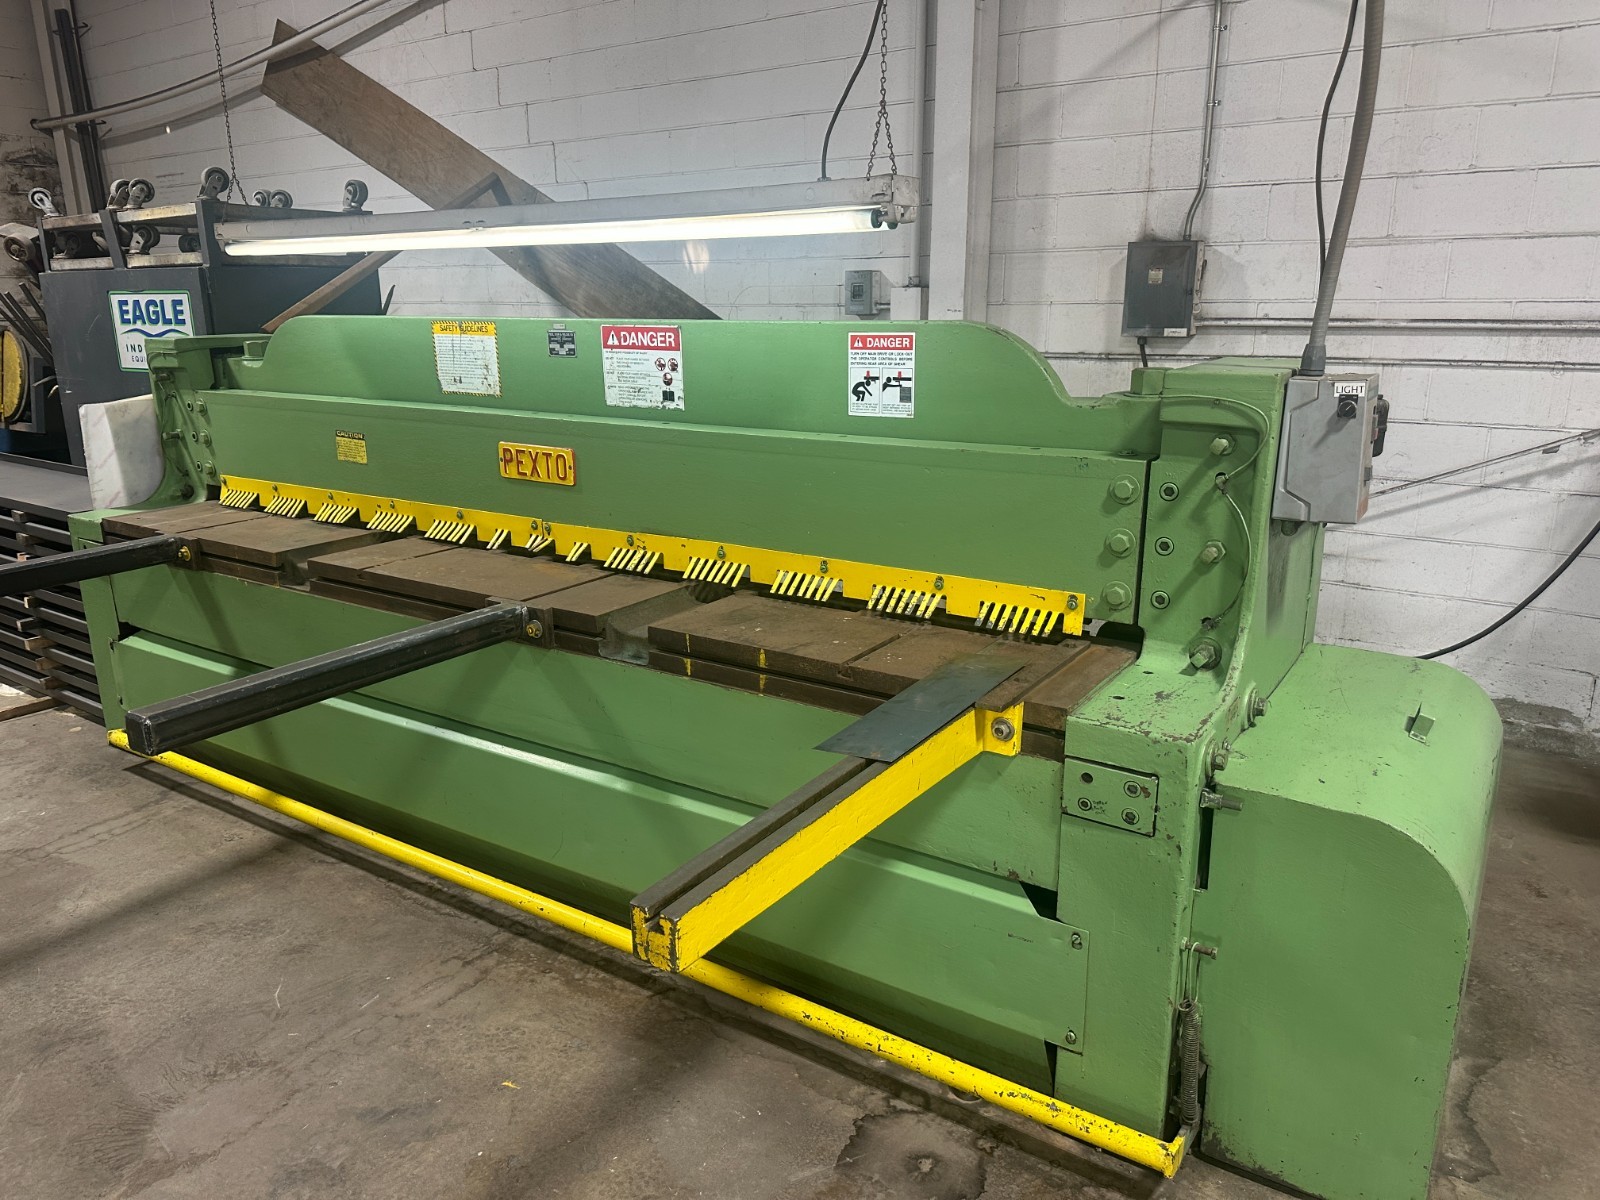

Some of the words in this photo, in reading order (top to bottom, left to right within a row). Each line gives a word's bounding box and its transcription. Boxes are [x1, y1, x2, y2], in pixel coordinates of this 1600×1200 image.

[117, 299, 187, 325] EAGLE
[459, 325, 488, 333] GUIDELINES
[620, 331, 675, 347] DANGER
[866, 337, 910, 347] DANGER
[126, 344, 143, 352] IND
[1336, 385, 1365, 393] LIGHT
[336, 430, 363, 439] CAUTION
[502, 446, 569, 481] PEXTO
